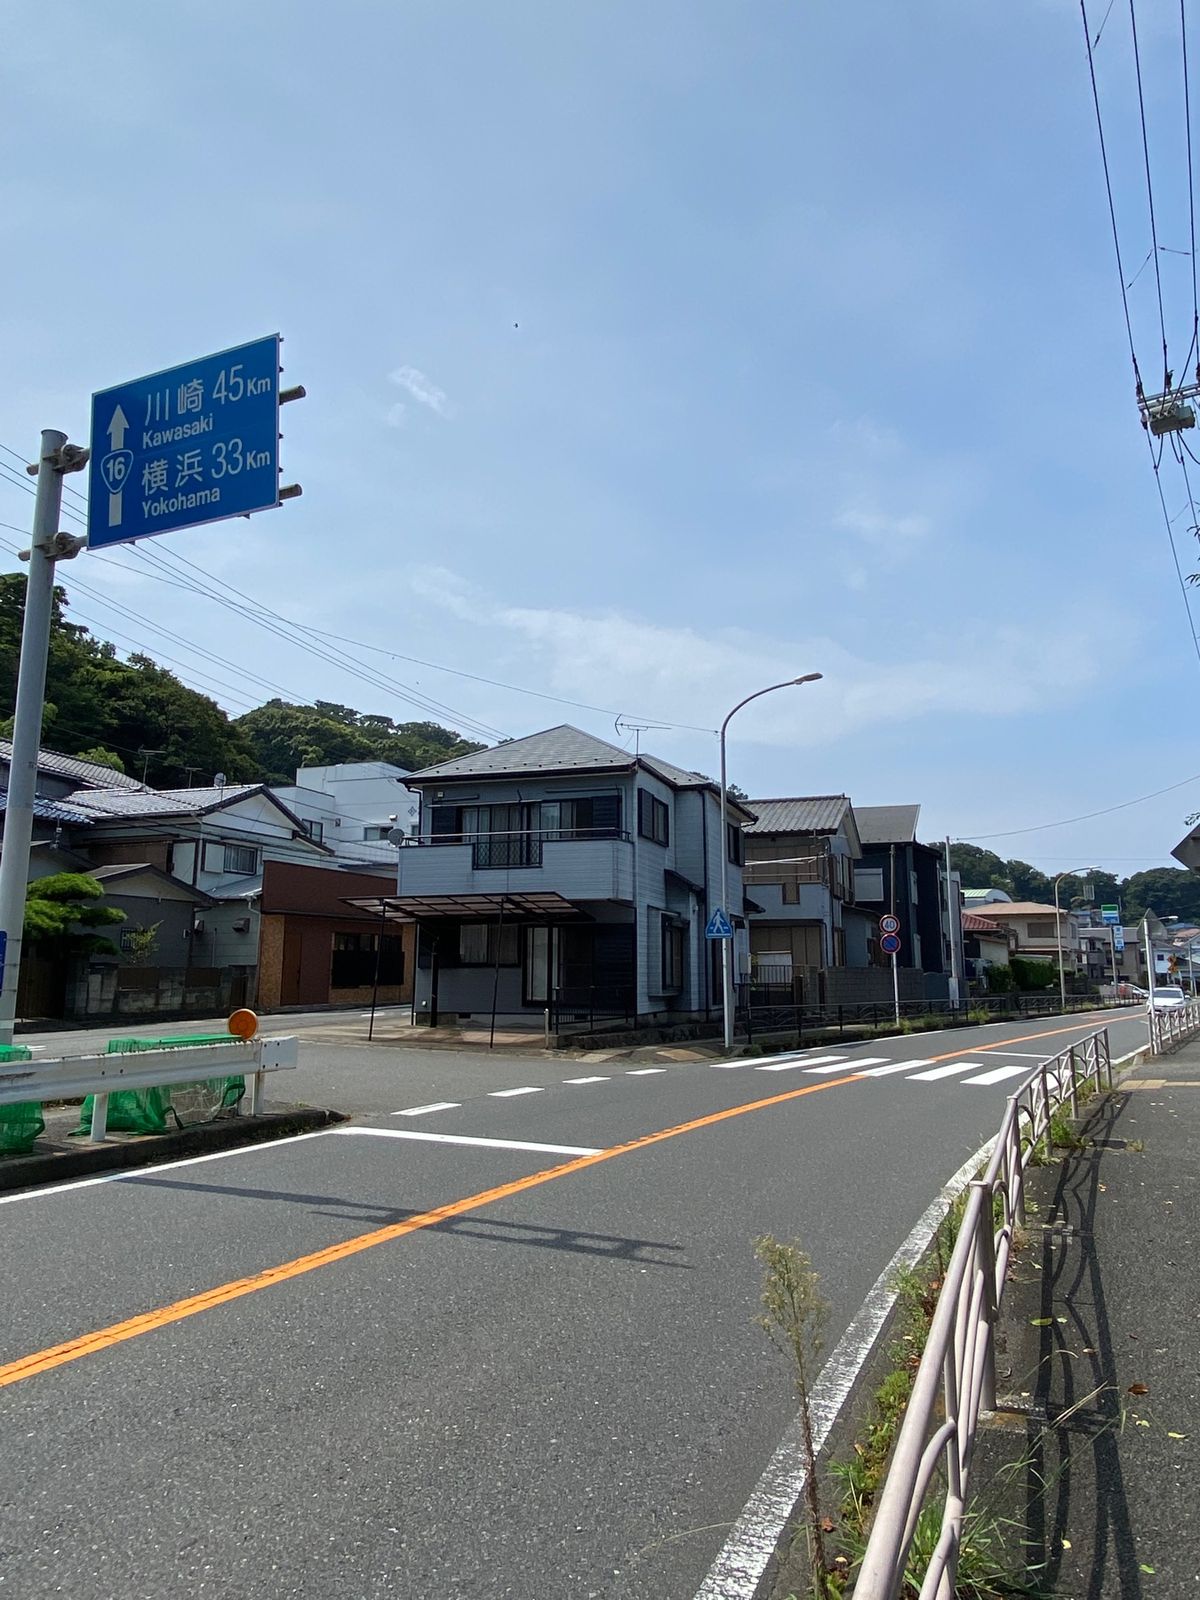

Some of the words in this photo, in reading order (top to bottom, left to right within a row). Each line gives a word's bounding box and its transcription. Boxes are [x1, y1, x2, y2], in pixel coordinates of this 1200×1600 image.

[145, 379, 204, 426] 川崎
[142, 413, 214, 449] Kawasaki
[106, 456, 125, 482] 16
[141, 449, 203, 496] 横浜
[142, 487, 221, 518] Yokohama
[885, 920, 896, 930] 40
